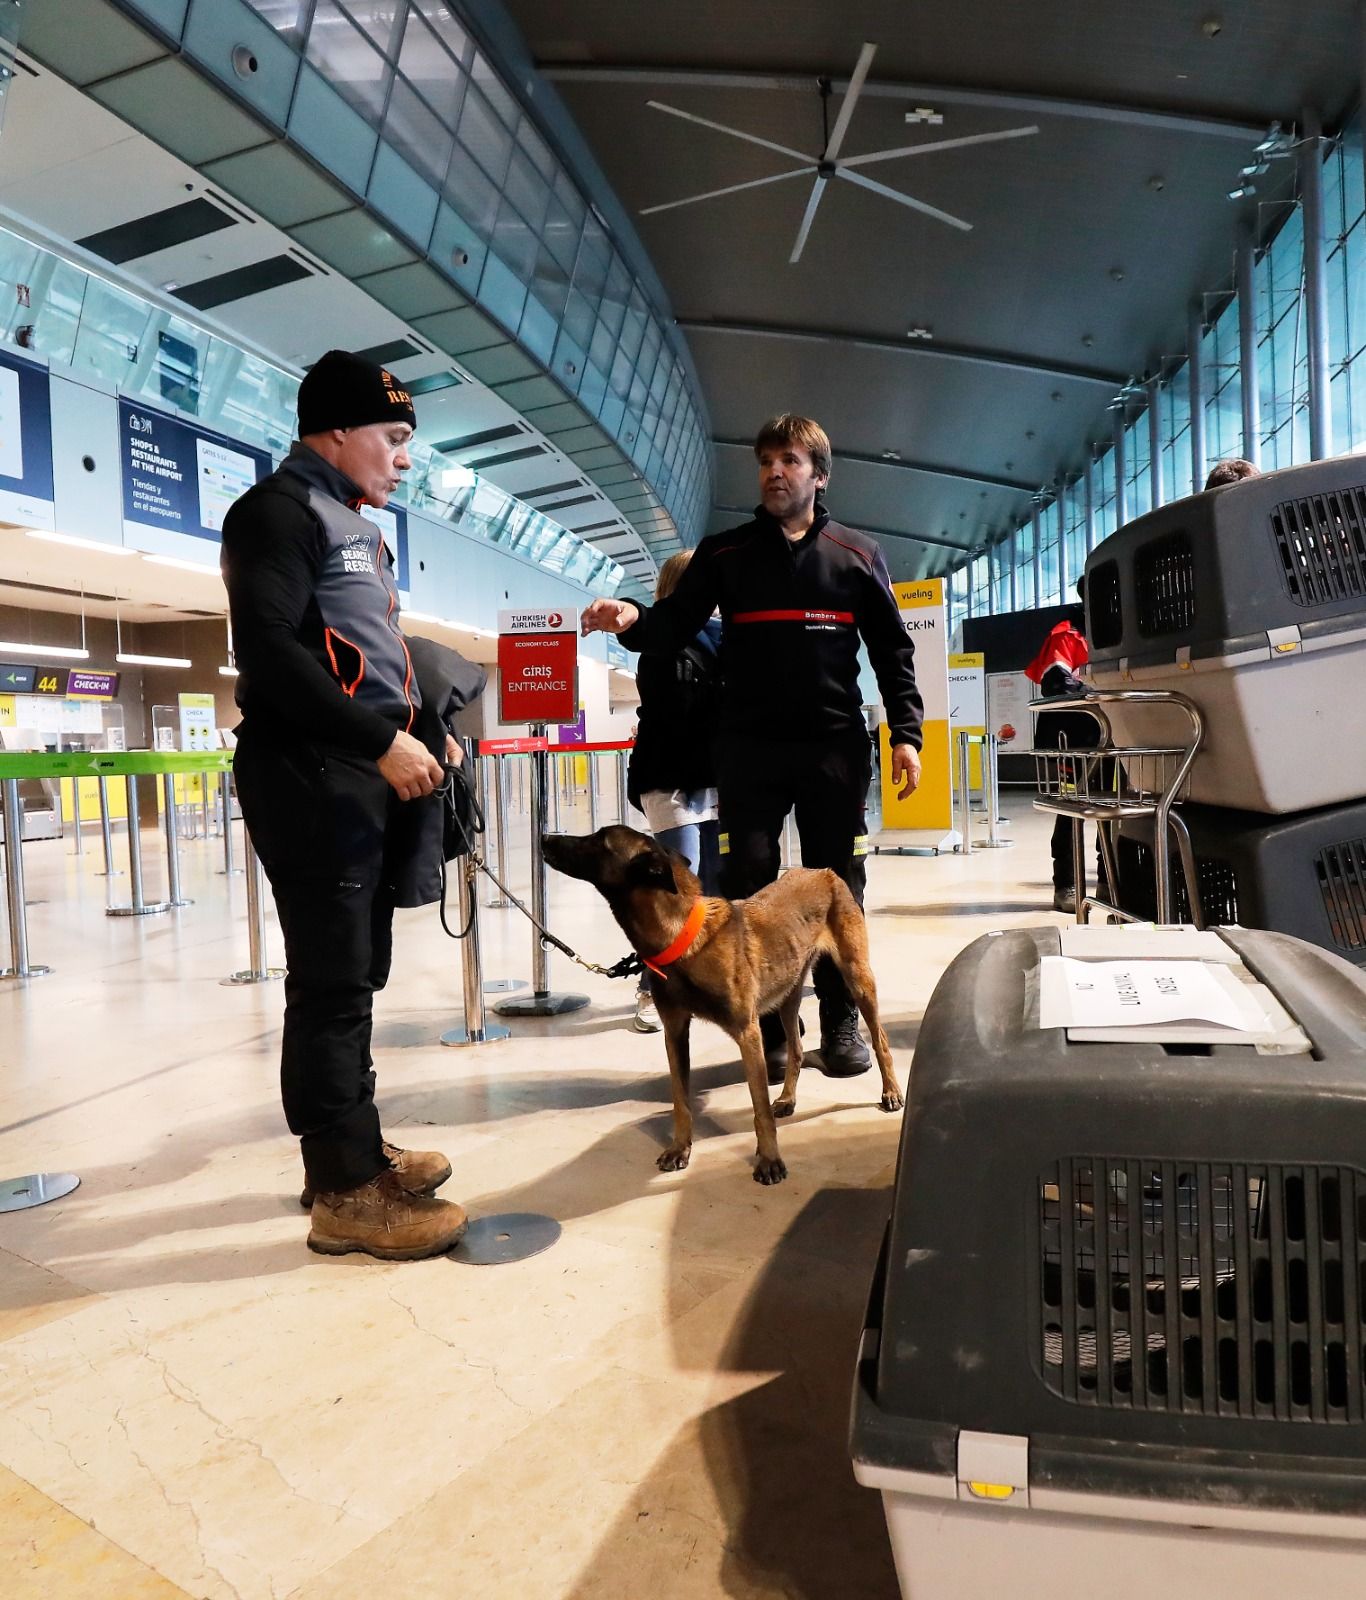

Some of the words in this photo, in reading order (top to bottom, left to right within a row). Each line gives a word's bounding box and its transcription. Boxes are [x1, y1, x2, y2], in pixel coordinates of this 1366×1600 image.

[130, 437, 153, 451] SHOPS
[153, 445, 160, 453] &
[131, 448, 177, 470] RESTAURANTS
[131, 459, 141, 469] AT
[141, 462, 155, 473] THE
[155, 466, 183, 481] AIRPORT
[132, 478, 154, 490] Tiendas
[133, 491, 171, 506] restaurantes
[142, 503, 149, 511] el
[149, 505, 181, 519] aeropuerto
[901, 588, 933, 600] vueling
[511, 614, 546, 622] TURKISH
[804, 611, 836, 620] Bombers
[511, 621, 546, 629] AIRLINES
[522, 664, 552, 679] GİRİŞ
[38, 676, 58, 692] 44
[948, 675, 977, 683] CHECK-IN
[73, 680, 110, 691] CHECK-IN
[508, 680, 567, 692] ENTRANCE
